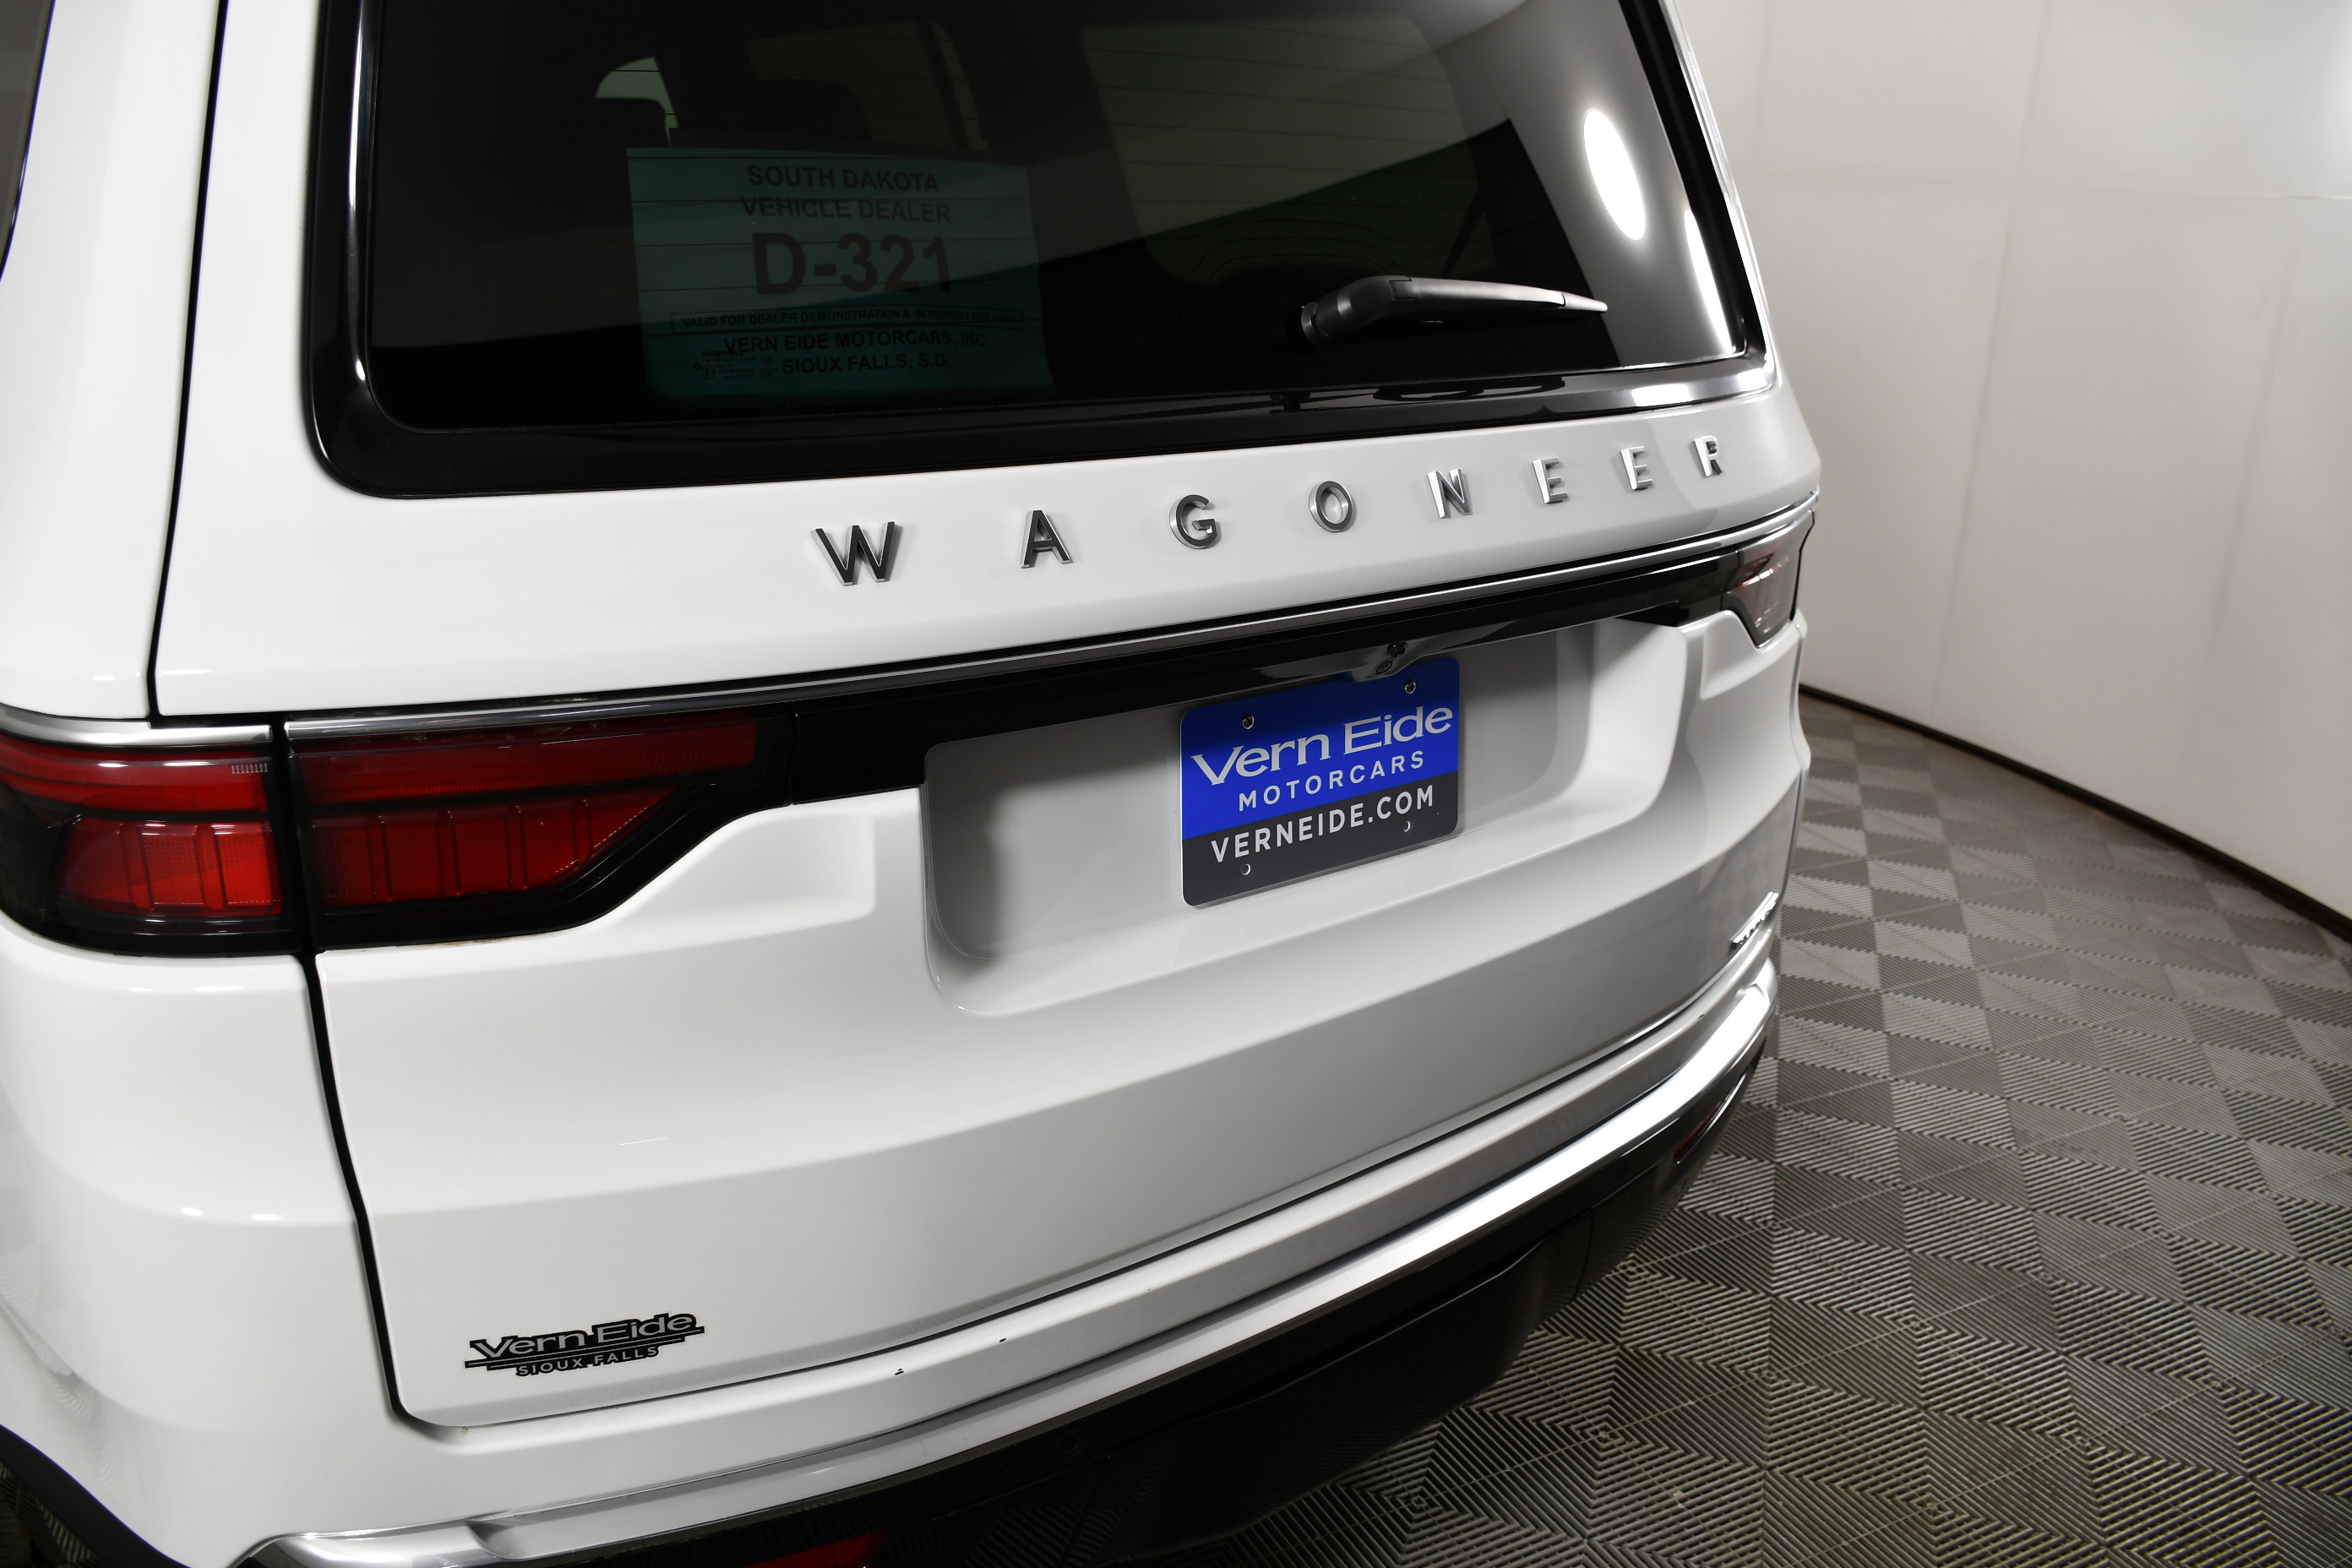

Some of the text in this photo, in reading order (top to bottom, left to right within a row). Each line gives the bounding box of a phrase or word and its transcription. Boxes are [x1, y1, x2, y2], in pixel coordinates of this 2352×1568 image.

[748, 166, 939, 193] SOUTH DAKOTA
[740, 197, 952, 223] VEHICLE DEALER
[753, 232, 951, 296] D-321
[682, 317, 717, 328] VALID
[721, 315, 746, 326] FOR
[749, 313, 797, 324] DEALER
[801, 309, 900, 322] DEMONSTRATION
[916, 309, 969, 320] IN-TRANSIT
[972, 312, 990, 323] USE
[723, 330, 991, 354] VERN EIDE MOTORCARS, INC.
[782, 356, 845, 374] SIOUX
[848, 353, 912, 371] FALLS,
[918, 352, 951, 368] S.D.
[810, 434, 1723, 586] WAGONEER
[1190, 705, 1453, 785] Vern Eide
[1239, 750, 1424, 812] MOTORCARS
[1211, 786, 1433, 863] VERNEIDE.COM
[472, 1315, 694, 1358] Vern Eide
[517, 1346, 657, 1375] SIOUX FALLS
